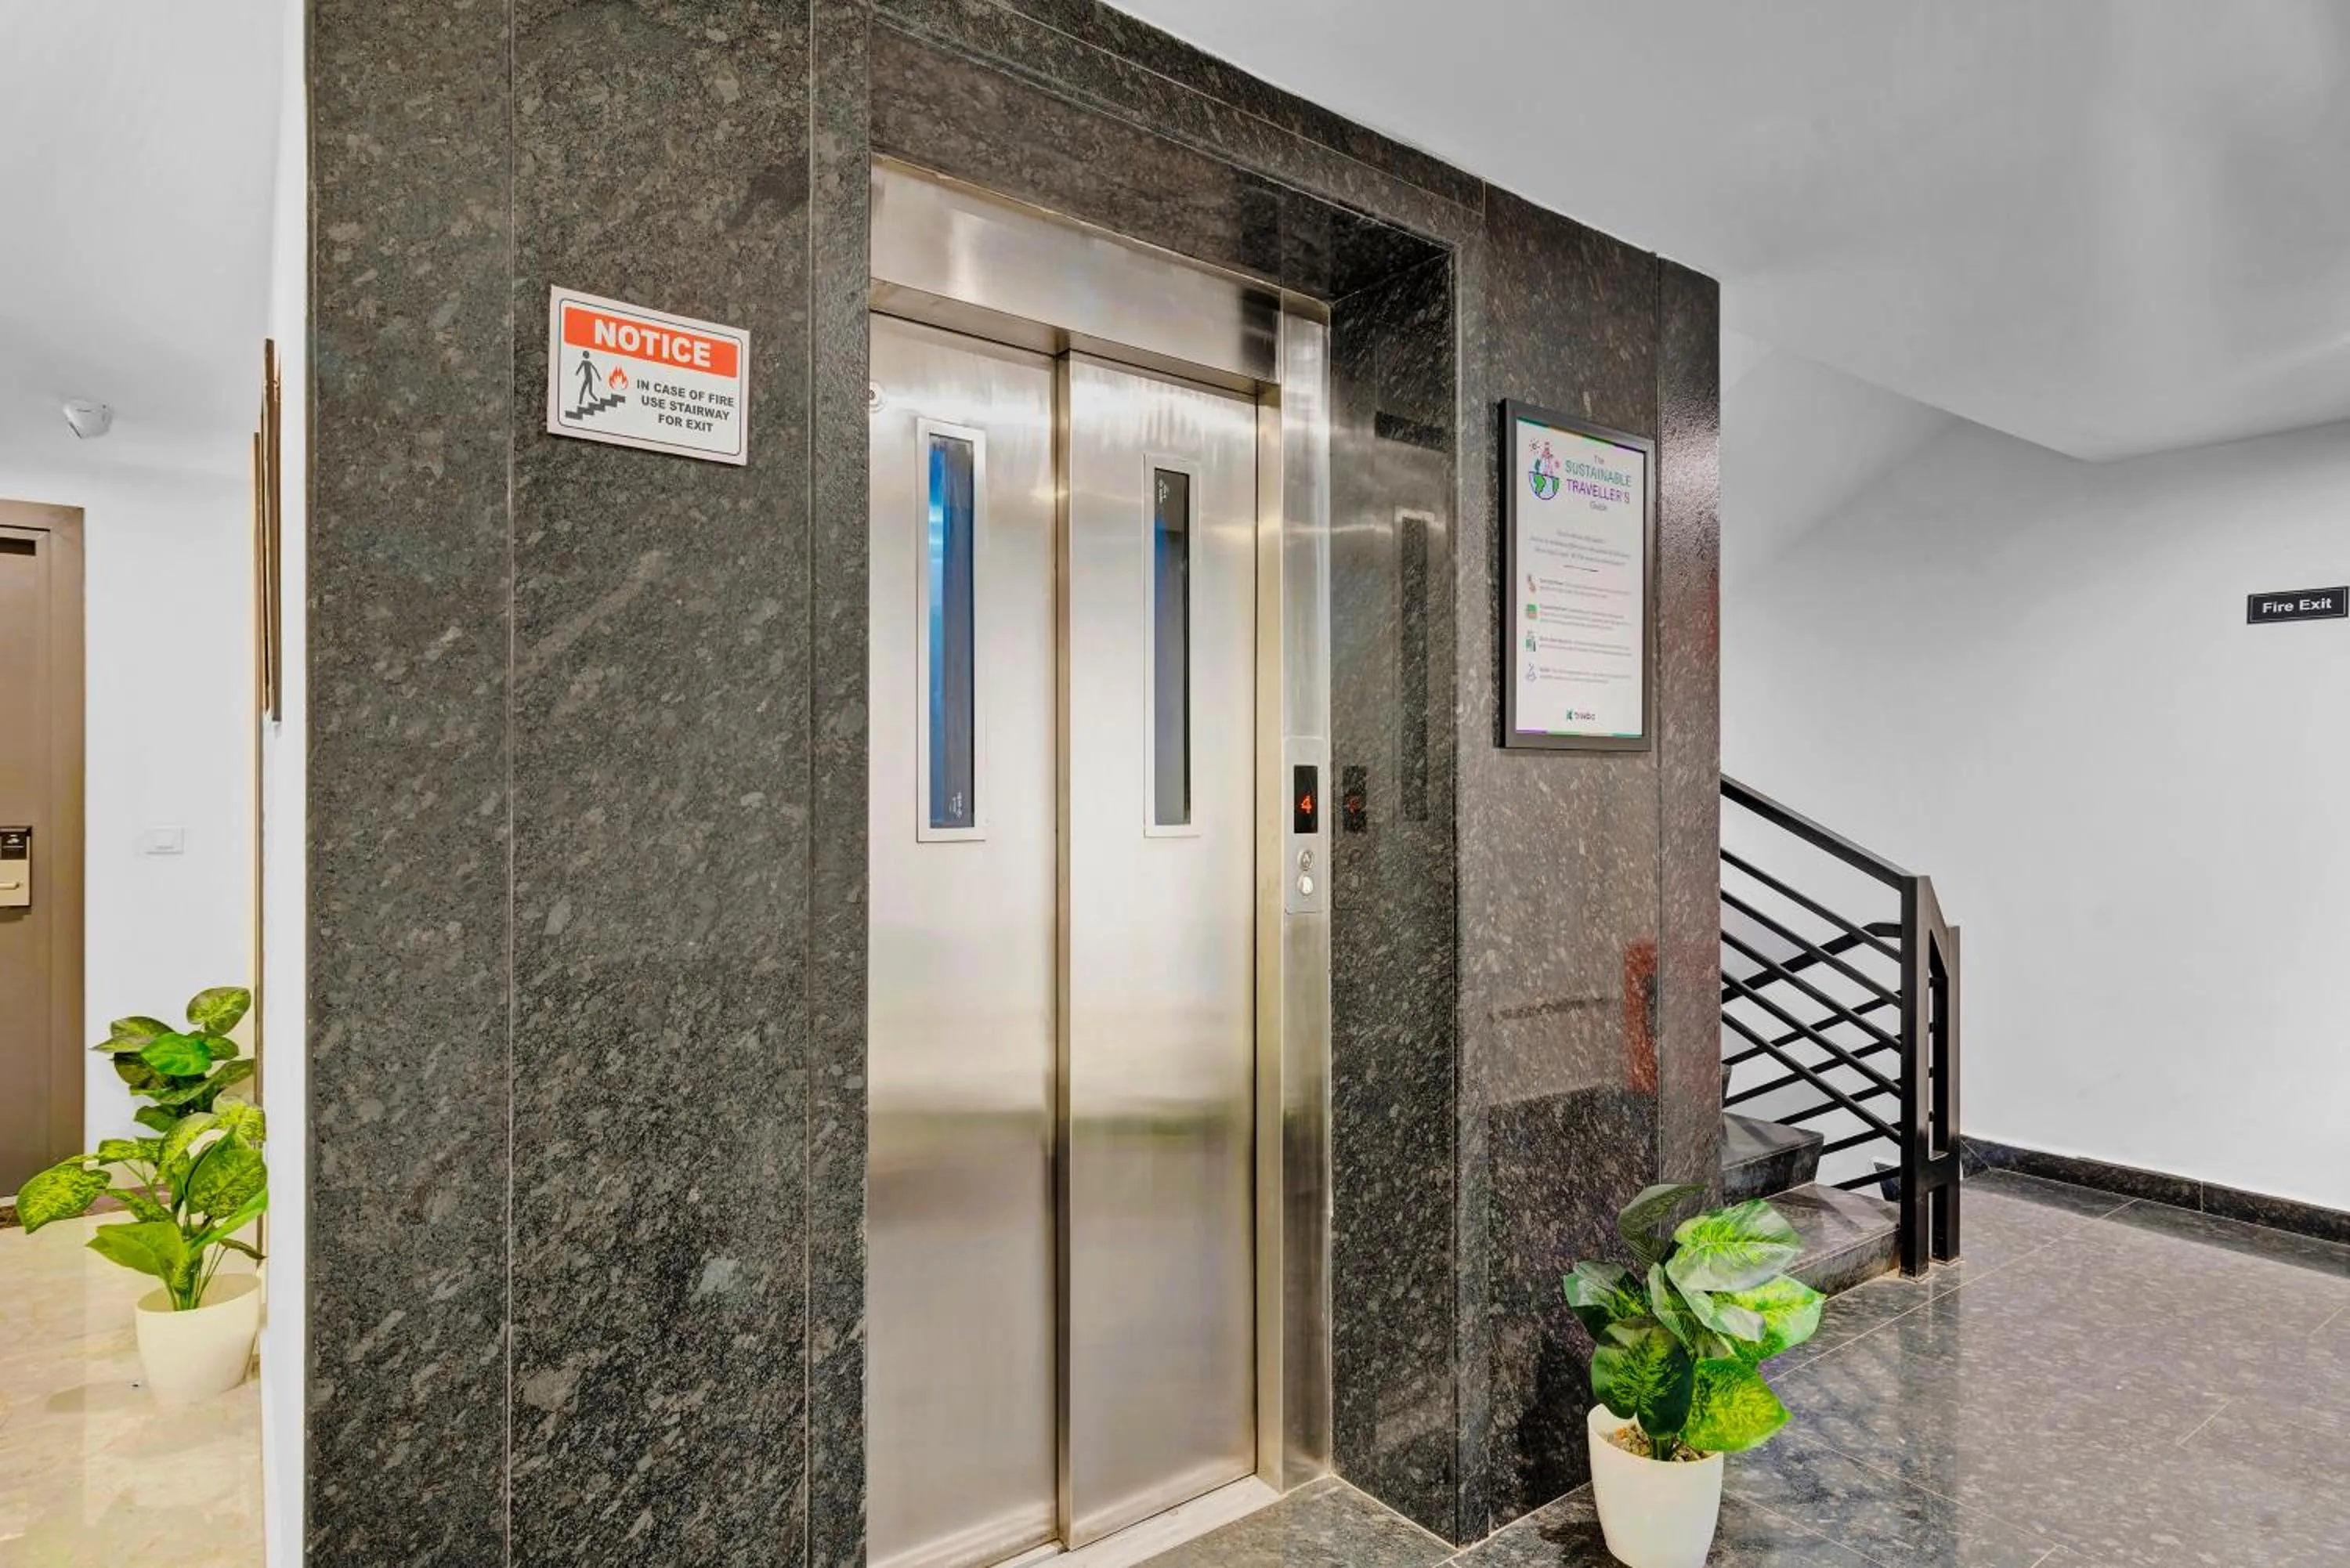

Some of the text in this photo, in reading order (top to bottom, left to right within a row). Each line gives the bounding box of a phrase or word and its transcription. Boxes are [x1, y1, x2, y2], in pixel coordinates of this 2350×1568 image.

[595, 319, 711, 367] NOTICE
[637, 379, 735, 407] IN CASE OF FIRE
[642, 396, 730, 421] USE STAIRWAY
[658, 414, 714, 432] FOR EXIT
[1565, 460, 1632, 487] SUSTAINABLE
[1567, 479, 1630, 504] TRAVELLER'S
[2262, 598, 2332, 613] Fire Exit
[1301, 795, 1312, 814] 4
